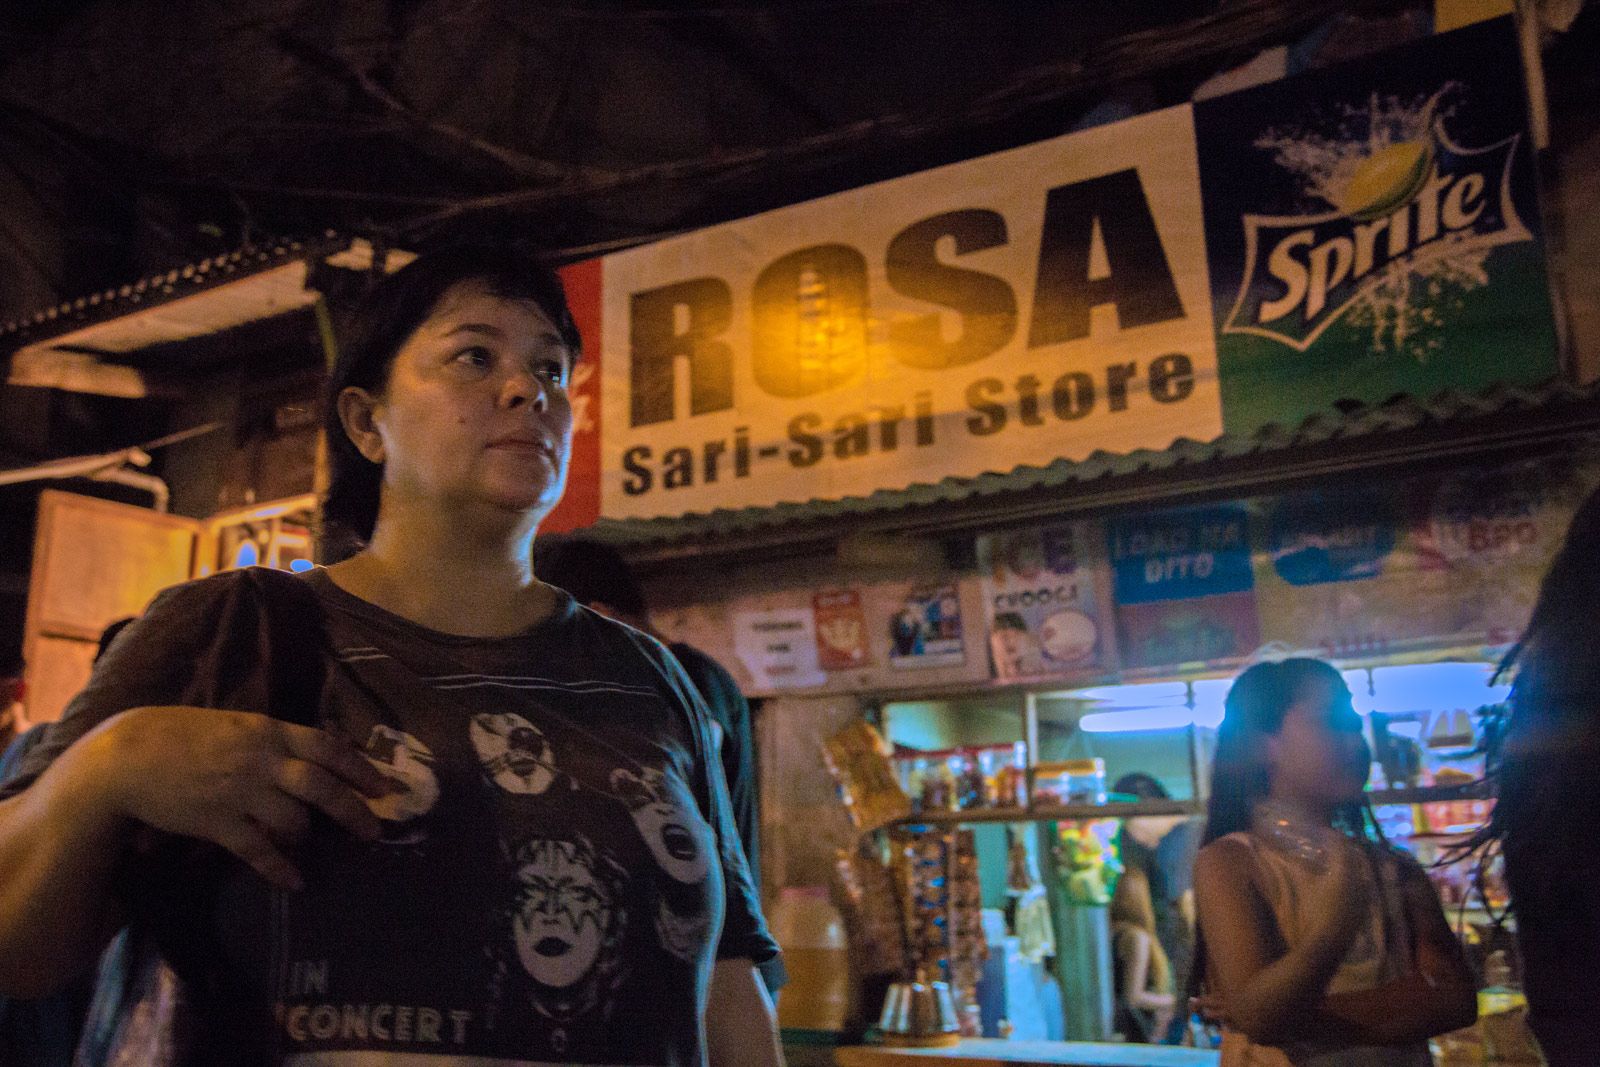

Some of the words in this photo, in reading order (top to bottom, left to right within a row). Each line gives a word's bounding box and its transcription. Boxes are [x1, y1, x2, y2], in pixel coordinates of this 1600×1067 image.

[629, 167, 1186, 429] ROSA
[1258, 160, 1486, 323] Sprite
[622, 393, 934, 495] Sari-Sari
[965, 350, 1195, 437] Store
[286, 1003, 472, 1043] CONCERT
[289, 959, 329, 994] IN
